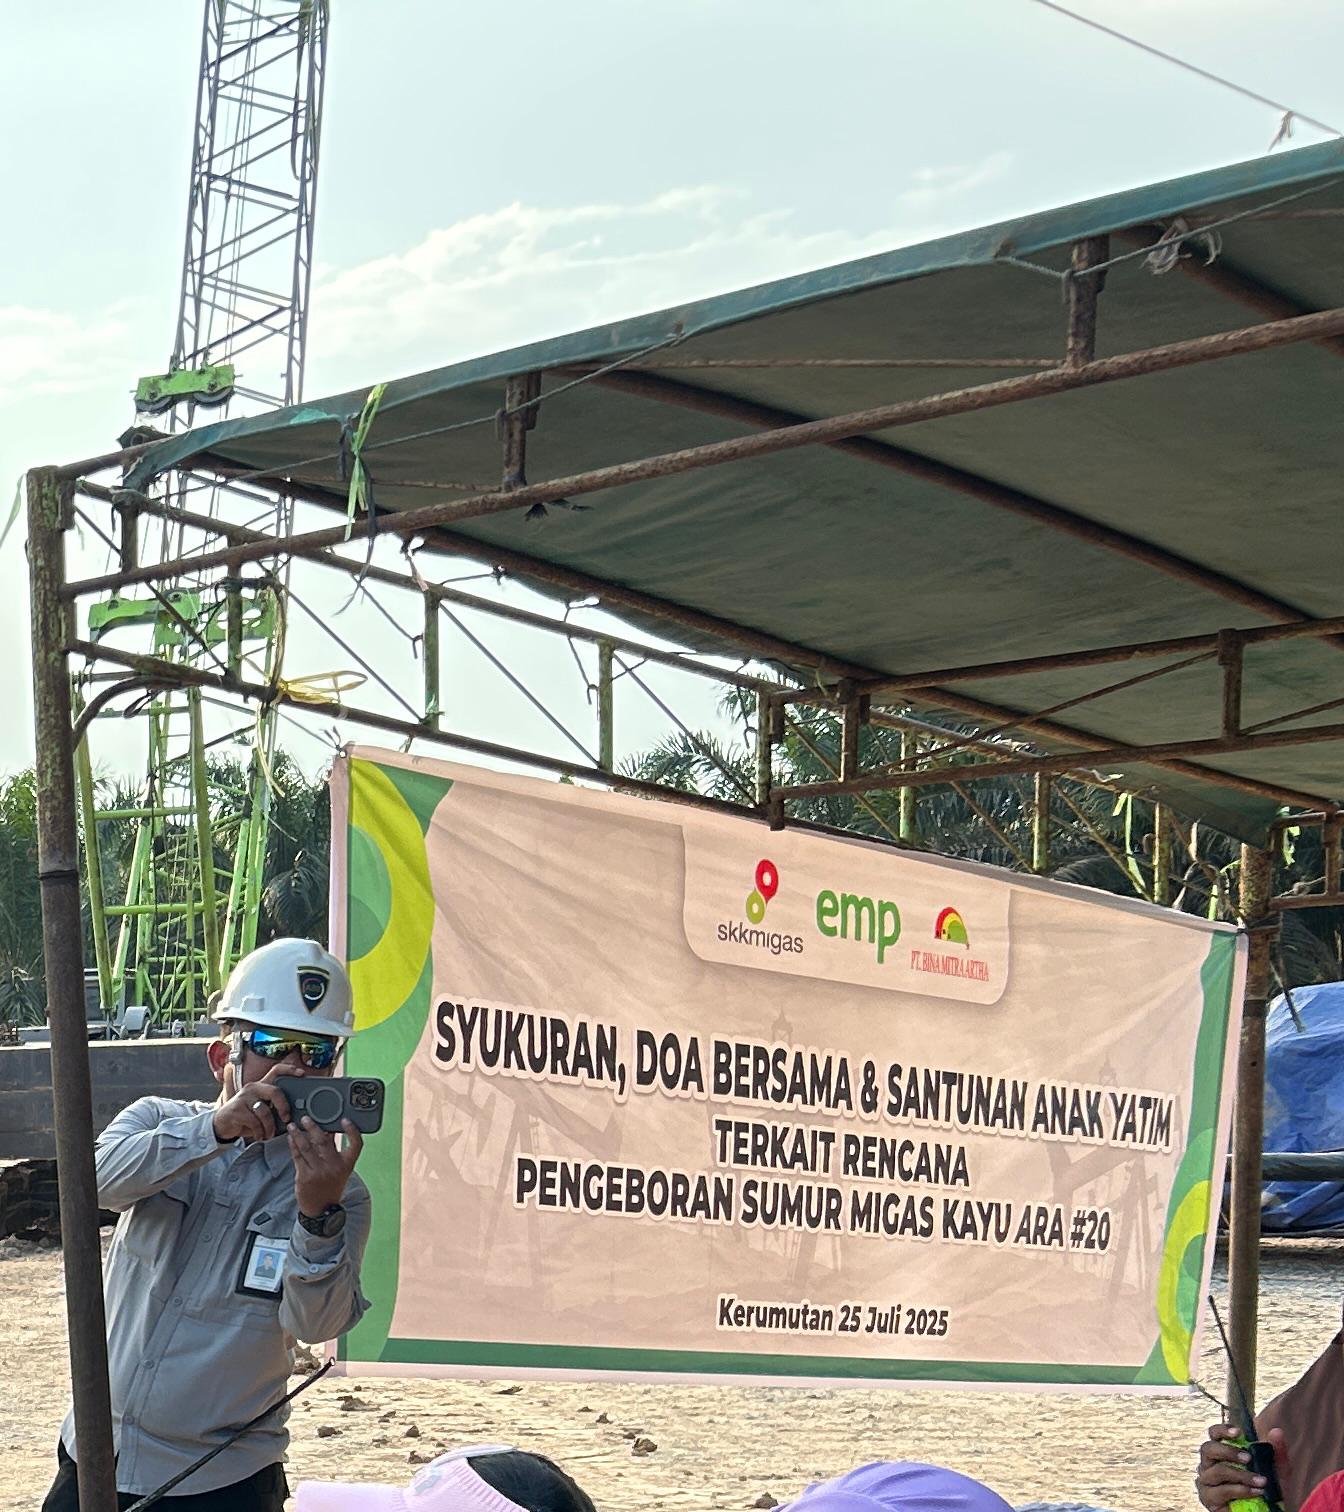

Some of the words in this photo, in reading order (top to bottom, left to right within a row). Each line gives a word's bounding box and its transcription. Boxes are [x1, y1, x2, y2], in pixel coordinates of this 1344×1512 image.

[717, 921, 804, 955] skkmigas
[816, 889, 901, 964] emp
[435, 1000, 625, 1096] SYUKURAN,
[636, 1029, 705, 1093] DOA
[713, 1040, 853, 1111] BERSAMA
[862, 1060, 879, 1114] &
[887, 1063, 1028, 1131] SANTUNAN
[1031, 1083, 1104, 1139] ANAK
[1109, 1091, 1174, 1148] YATIM
[714, 1118, 835, 1174] TERKAIT
[843, 1134, 970, 1187] RENCANA
[516, 1157, 734, 1221] PENGEBORAN
[741, 1178, 842, 1230] SUMUR
[850, 1190, 934, 1238] MIGAS
[942, 1199, 1012, 1243] KAYU
[1013, 1205, 1063, 1247] ARA
[1070, 1209, 1111, 1250] #20
[718, 1298, 833, 1331] Kerumutan
[838, 1304, 862, 1332] 25
[865, 1304, 902, 1334] Juli
[905, 1308, 949, 1336] 2025
